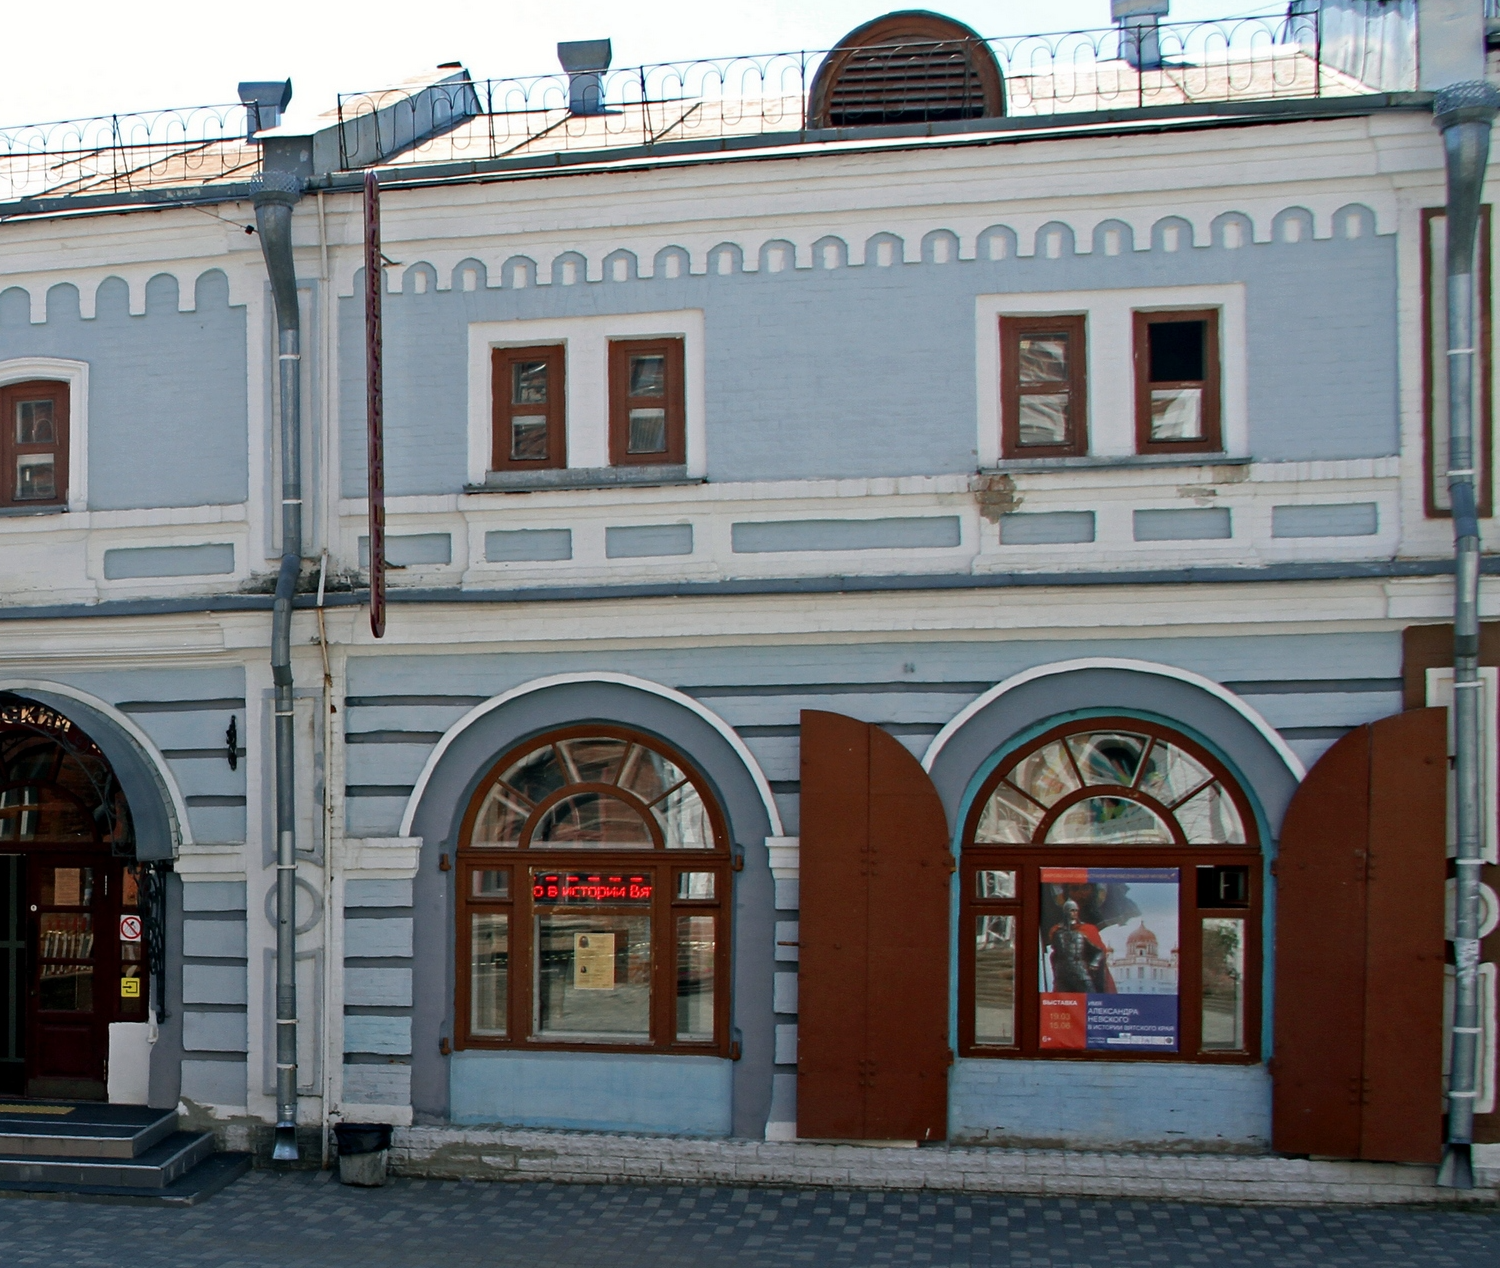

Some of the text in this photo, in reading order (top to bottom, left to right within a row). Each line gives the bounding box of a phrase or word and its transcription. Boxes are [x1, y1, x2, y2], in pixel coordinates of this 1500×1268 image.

[562, 886, 626, 900] истории
[629, 884, 652, 898] Вя
[1042, 999, 1078, 1007] ВЫСТАВКА
[1088, 1008, 1139, 1016] АЛЕКСАНДРА
